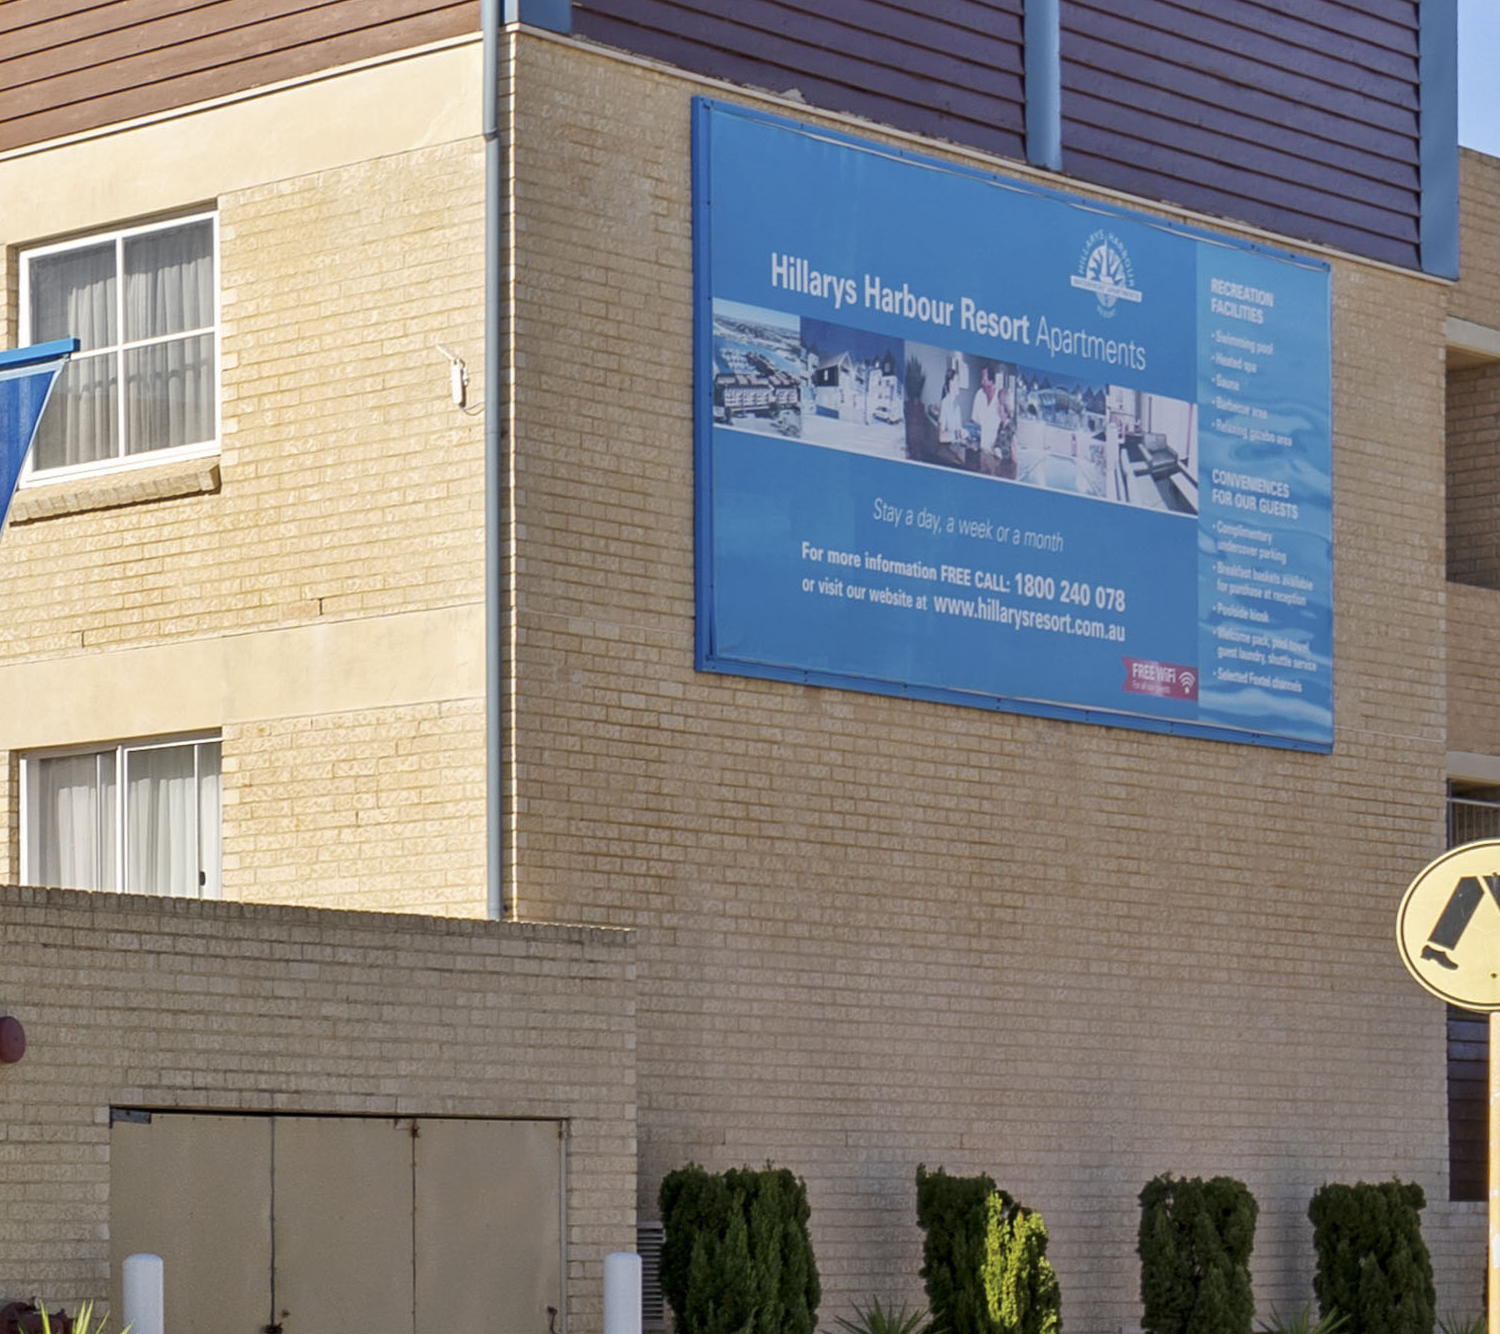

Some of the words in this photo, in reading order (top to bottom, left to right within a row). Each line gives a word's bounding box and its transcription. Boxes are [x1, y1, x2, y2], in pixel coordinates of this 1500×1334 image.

[1211, 277, 1274, 307] RECREATION
[771, 252, 857, 309] Hillarys
[864, 274, 954, 327] Harbour
[961, 297, 1031, 345] Resort
[1036, 316, 1147, 370] Apartments
[1211, 297, 1264, 324] FACILITIES
[1215, 330, 1256, 354] Swimming
[1256, 342, 1274, 355] pool
[1215, 352, 1242, 369] Heated
[1276, 435, 1292, 447] area
[1212, 468, 1290, 498] CONVENIENCES
[1212, 488, 1233, 506] FOR
[1235, 493, 1257, 511] OUR
[1259, 498, 1299, 519] GUESTS
[873, 497, 902, 528] Stay
[905, 509, 913, 525] a
[916, 507, 942, 535] day,
[946, 517, 954, 533] a
[959, 519, 993, 540] week
[996, 526, 1010, 542] or
[1012, 529, 1020, 545] a
[1023, 532, 1064, 552] month
[1259, 548, 1287, 565] parking
[802, 541, 824, 562] For
[827, 549, 861, 567] more
[865, 551, 937, 581] information
[940, 564, 971, 587] FREE
[974, 570, 1010, 593] CALL:
[1015, 572, 1055, 600] 1800
[1060, 579, 1090, 606] 240
[1095, 586, 1126, 613] 078
[1217, 578, 1228, 592] for
[1272, 591, 1306, 606] reception
[802, 577, 815, 592] or
[818, 576, 844, 597] visit
[846, 584, 866, 600] our
[869, 587, 913, 609] website
[915, 594, 927, 610] at
[933, 595, 1126, 642] www.hillarysresort.com.au
[1132, 663, 1155, 680] FREE
